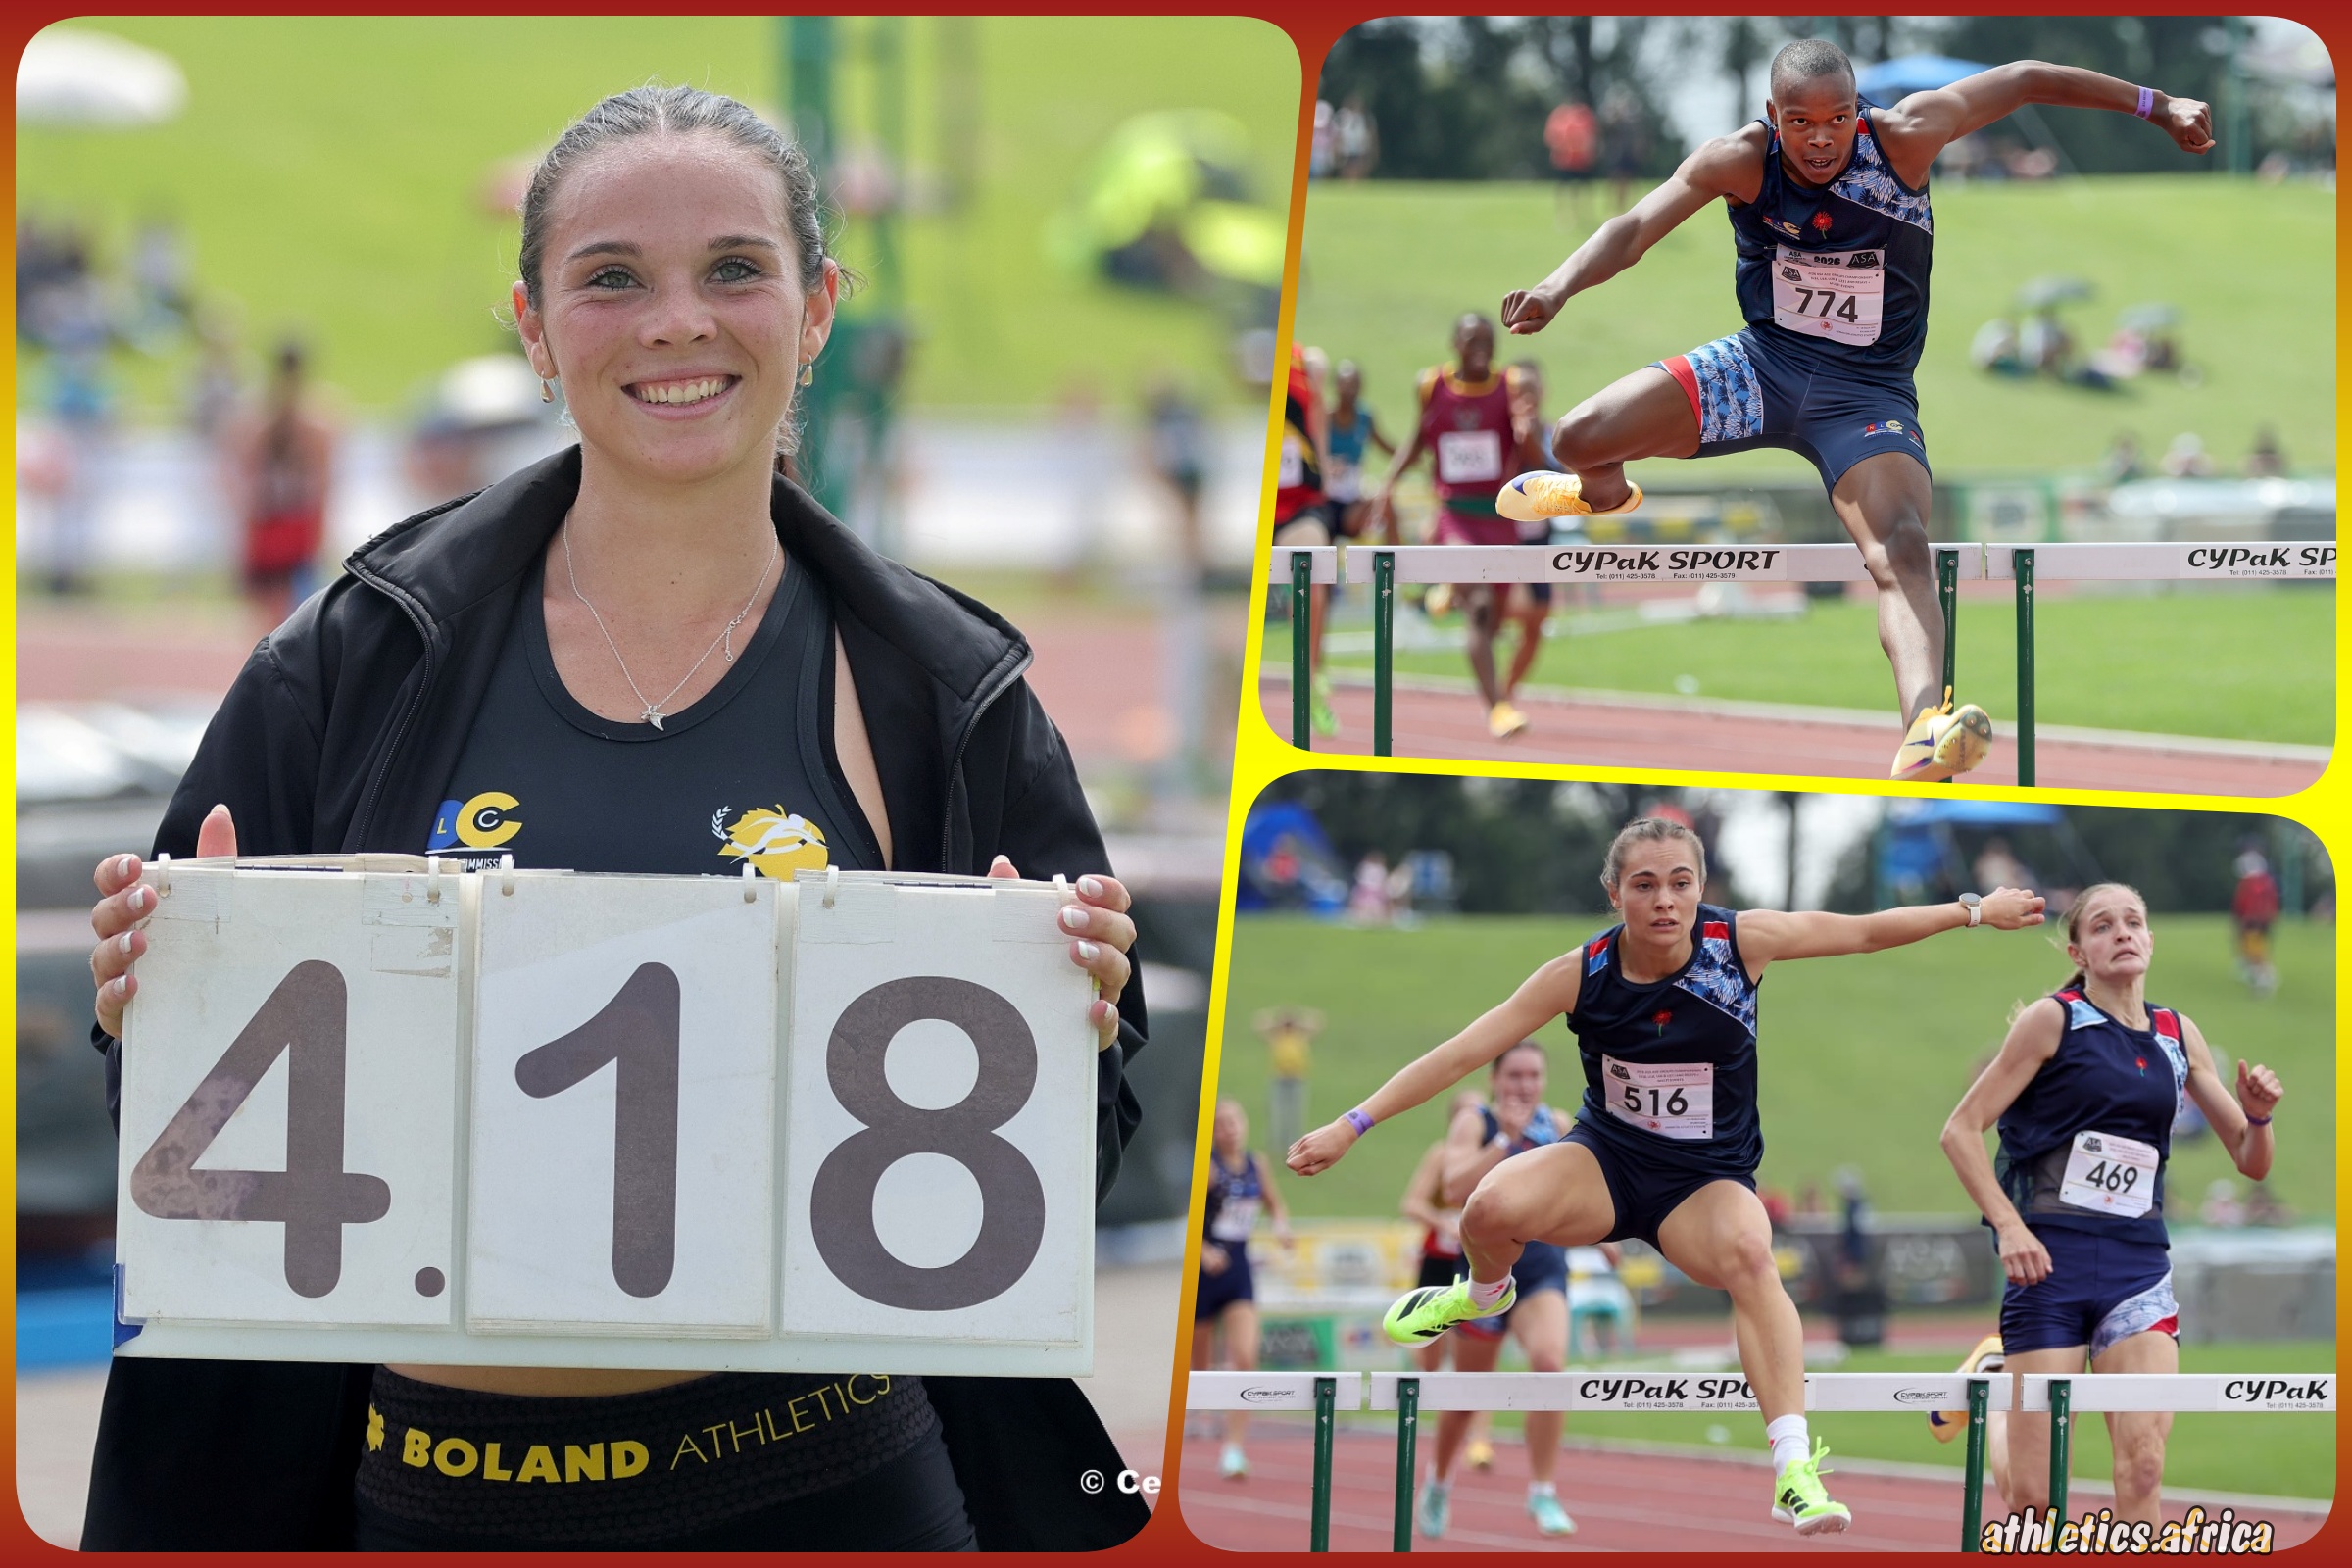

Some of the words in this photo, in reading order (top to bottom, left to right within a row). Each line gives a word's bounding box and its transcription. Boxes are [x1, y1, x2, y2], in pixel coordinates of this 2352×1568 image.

[1851, 253, 1877, 265] ASA
[1784, 266, 1800, 277] ASA
[1795, 287, 1858, 323] 774
[1668, 550, 1780, 571] SPORT
[1608, 572, 1625, 581] (011)
[465, 858, 515, 871] MMISSI
[1612, 1063, 1628, 1075] ASA
[1624, 1086, 1689, 1116] 516
[2085, 1160, 2138, 1194] 469
[1696, 1379, 1759, 1399] SPO
[402, 1427, 650, 1484] BOLAND
[670, 1373, 891, 1471] ATHLETICS
